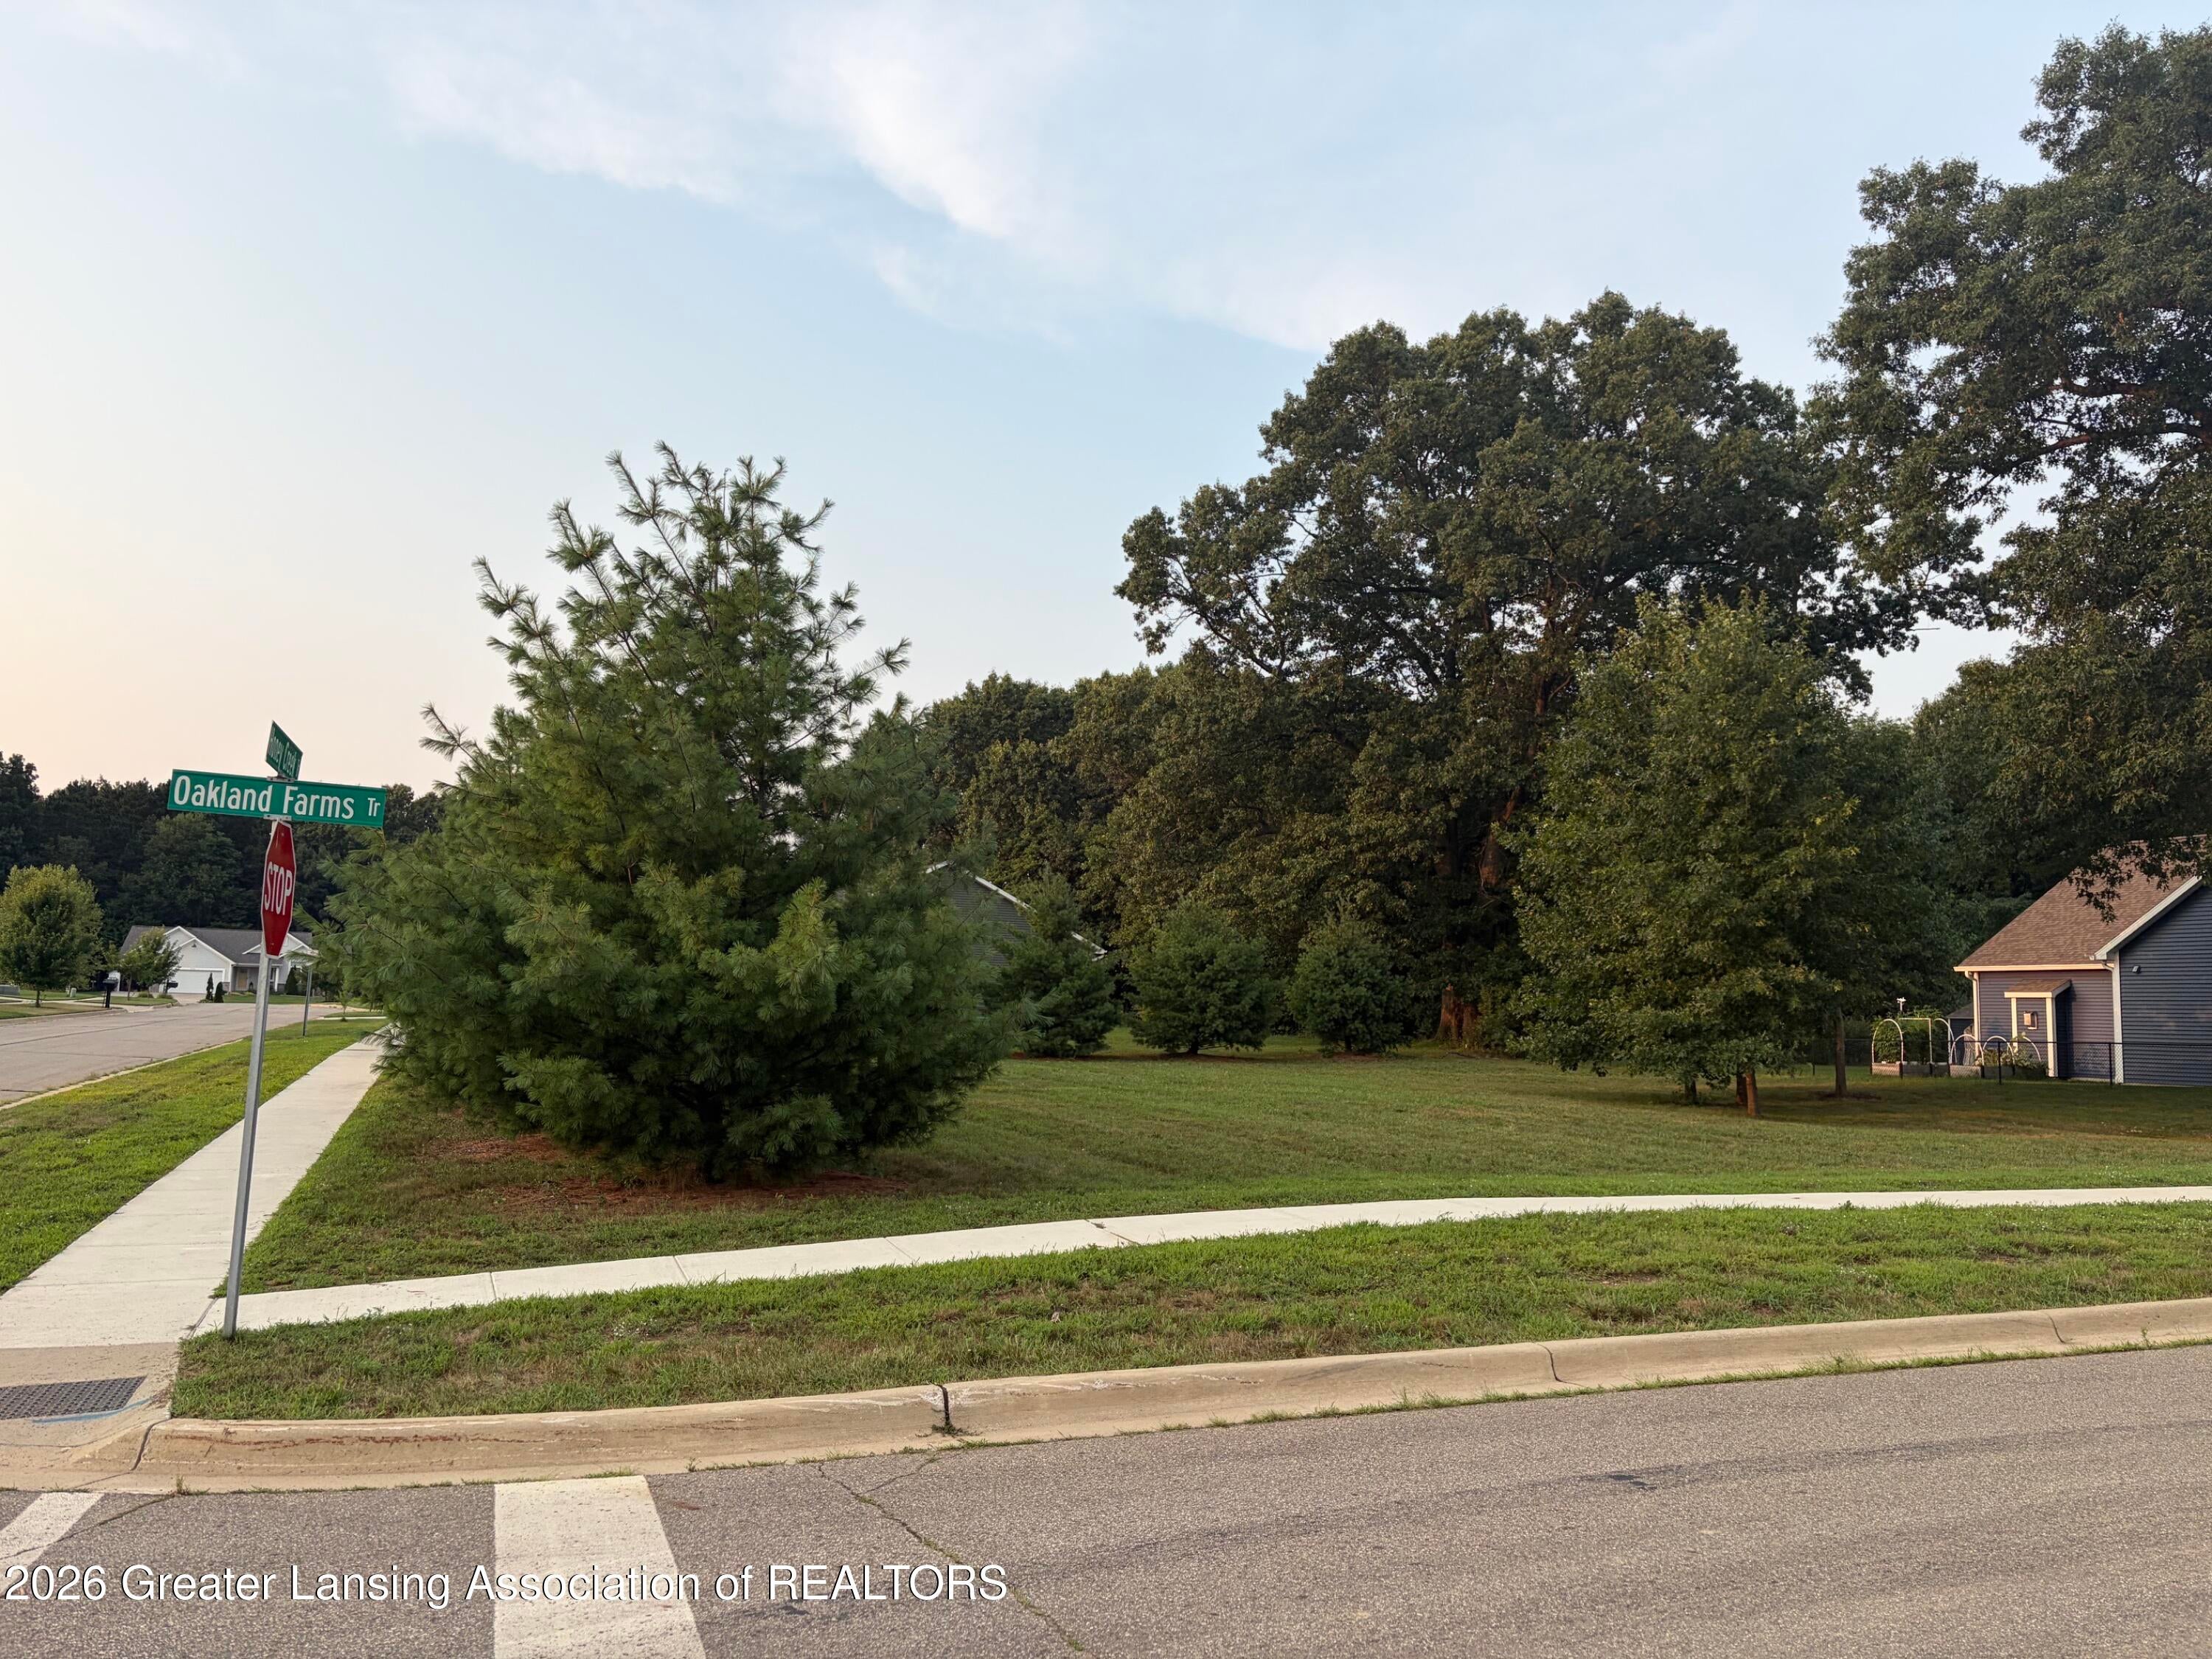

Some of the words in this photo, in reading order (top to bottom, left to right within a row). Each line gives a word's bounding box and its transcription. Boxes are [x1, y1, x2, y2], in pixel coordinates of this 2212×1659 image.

[173, 775, 273, 813] Oakland
[282, 785, 355, 820] Farms
[367, 797, 381, 817] Tr
[264, 861, 293, 916] STOP
